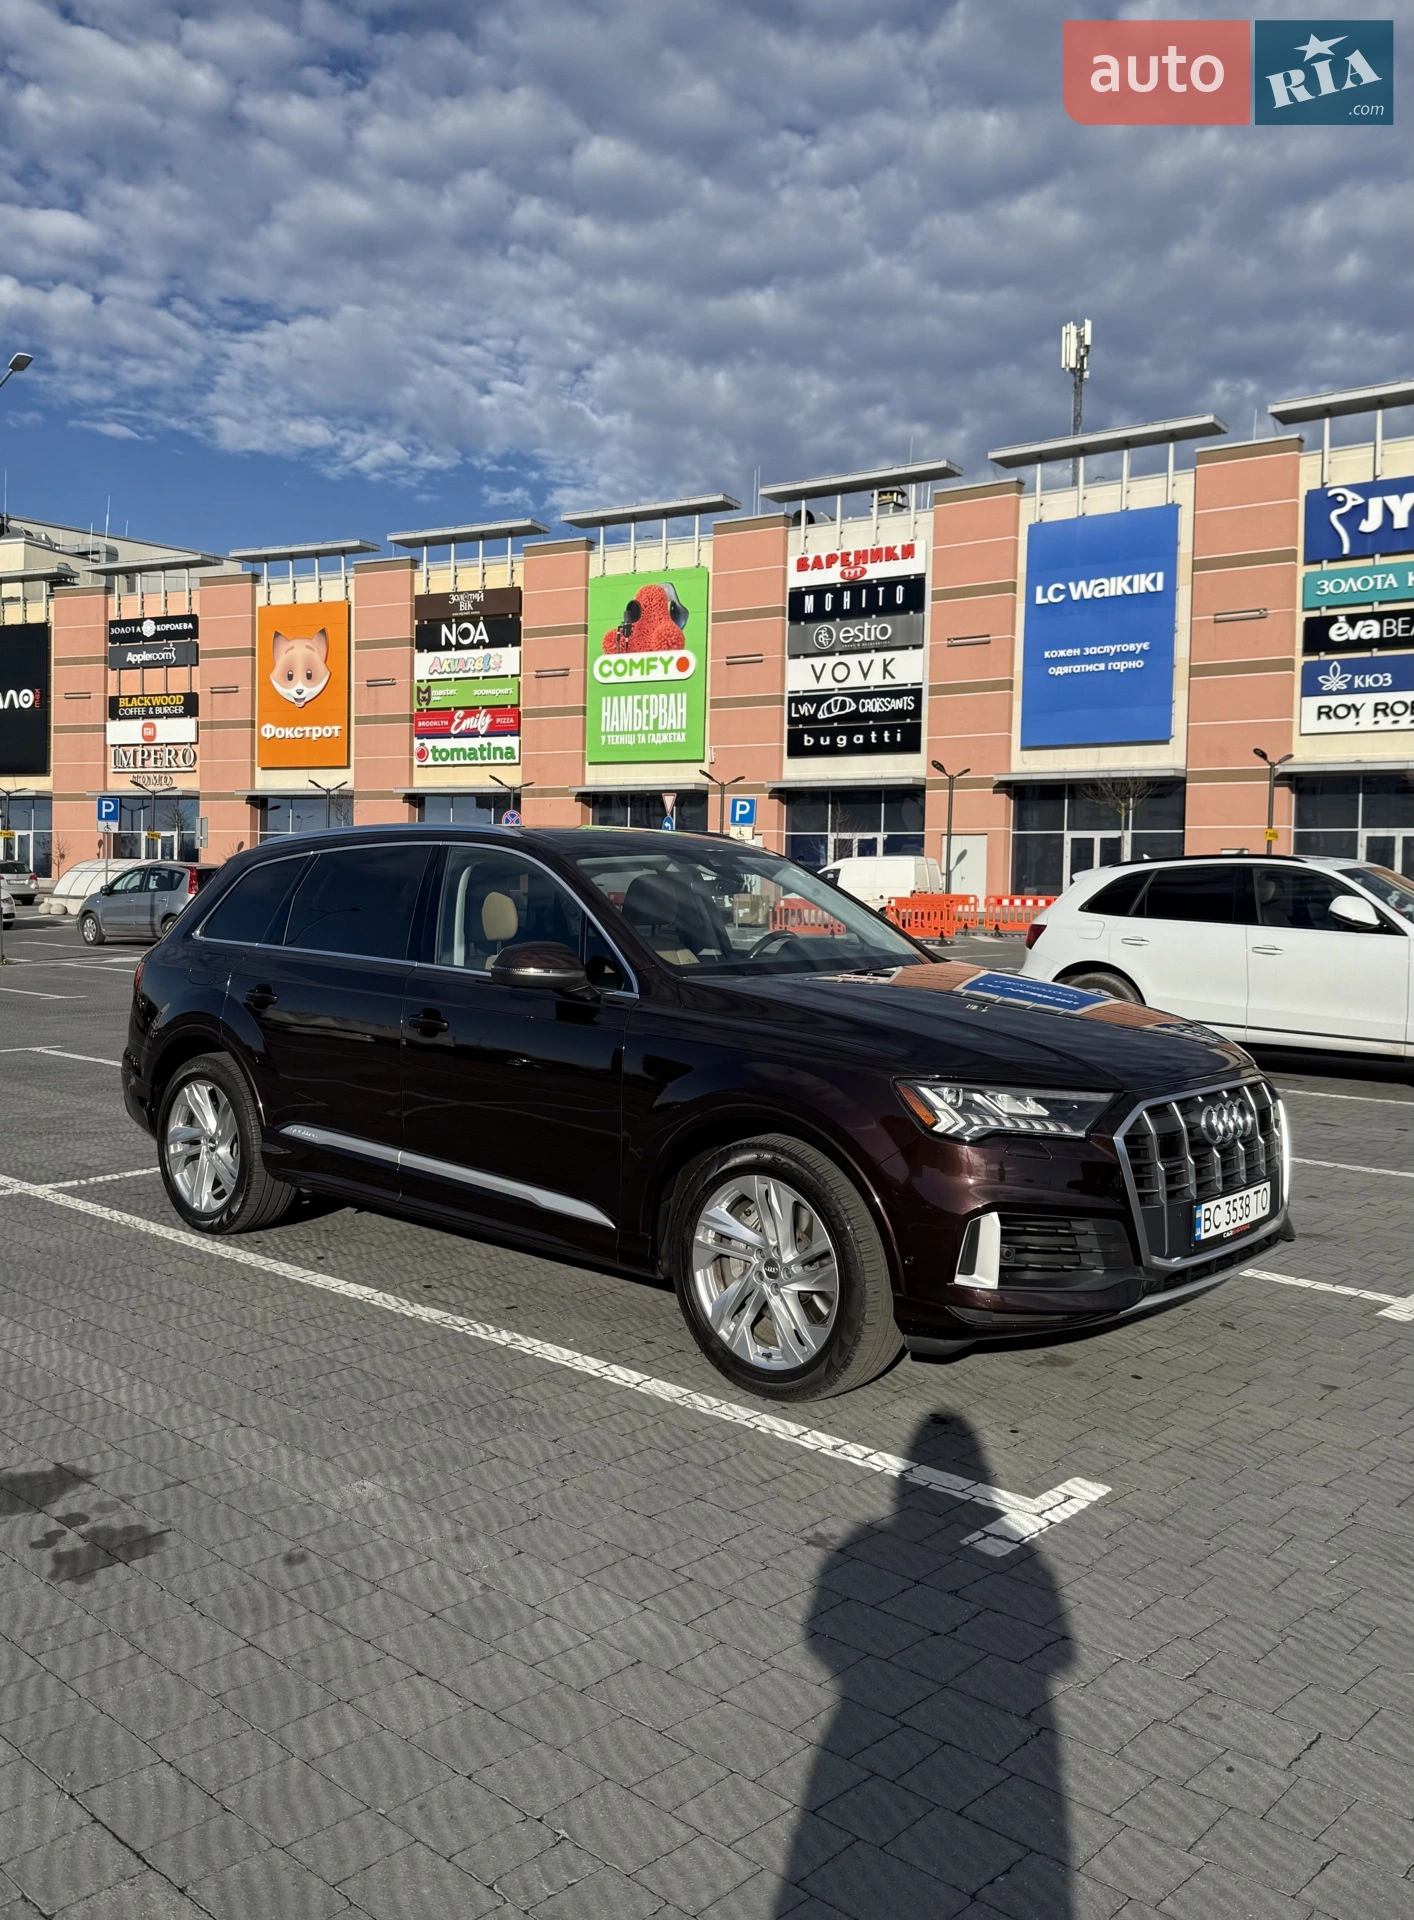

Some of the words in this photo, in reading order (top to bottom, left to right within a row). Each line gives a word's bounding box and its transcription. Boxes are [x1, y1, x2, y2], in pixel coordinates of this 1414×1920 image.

[796, 543, 915, 572] ВАРЕНИКИ
[843, 568, 863, 578] ТУТ
[1035, 583, 1066, 605] LC
[1316, 573, 1398, 595] ЗОЛОТА
[804, 585, 905, 614] MOHITO
[156, 622, 194, 632] КОРОЛЕВА
[441, 621, 489, 646] NOA
[839, 622, 892, 643] estro
[126, 650, 172, 664] Appleroom
[1044, 648, 1081, 659] кожен
[1082, 641, 1151, 657] заслуговує
[599, 655, 674, 678] COMFY
[811, 657, 896, 685] VOVK
[1048, 663, 1105, 676] одягатися
[1108, 659, 1145, 673] гарно
[1353, 672, 1393, 689] КЮЗ
[118, 695, 184, 707] BLACKWOOD
[119, 706, 147, 716] COFFEE
[148, 706, 154, 715] &
[155, 705, 184, 715] BURGER
[450, 709, 493, 735] Emily
[601, 692, 687, 733] НАМБЕРВАН
[1317, 703, 1366, 721] ROY
[261, 723, 342, 741] Фокстрот
[601, 734, 606, 746] У
[607, 734, 636, 746] ТЕХНІЦІ
[637, 733, 646, 744] ТА
[647, 732, 687, 745] ГАДЖЕТАХ
[803, 729, 901, 748] bugatti
[111, 746, 196, 768] IMPERO
[430, 742, 516, 762] tomatina
[102, 801, 114, 819] P
[735, 801, 750, 821] P
[1203, 1204, 1222, 1234] BC
[1224, 1194, 1251, 1226] 3538
[1253, 1187, 1268, 1215] TO
